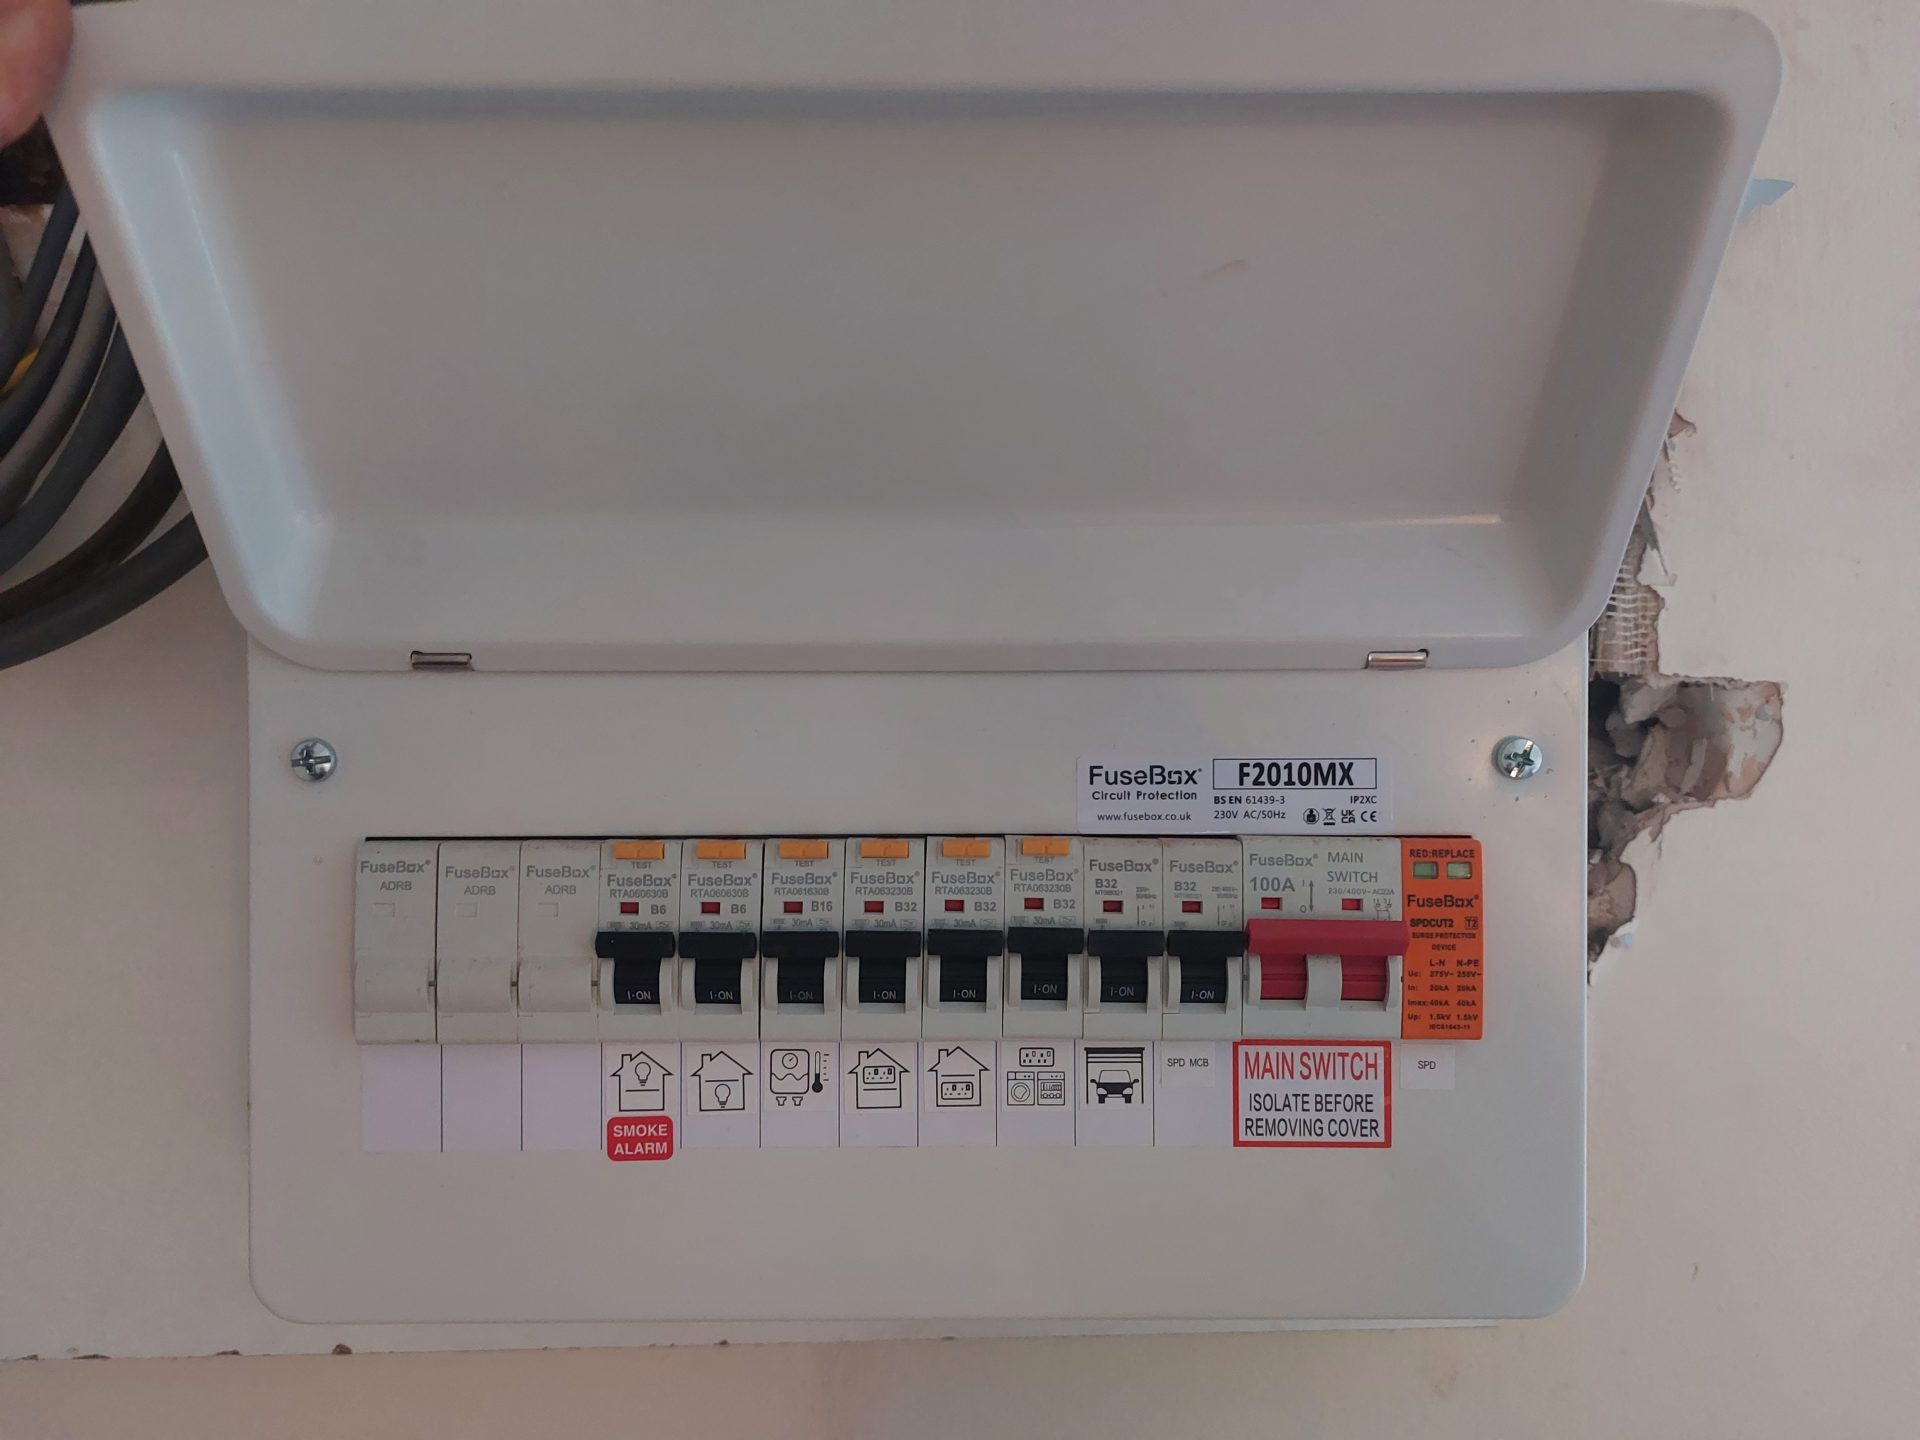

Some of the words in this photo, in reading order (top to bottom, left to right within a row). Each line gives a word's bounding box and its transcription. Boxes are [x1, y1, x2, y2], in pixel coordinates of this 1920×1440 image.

[1089, 764, 1199, 786] FuseBox
[1238, 761, 1354, 787] F2010MX
[1091, 789, 1131, 801] Circuit
[1136, 789, 1197, 801] Protection
[1213, 795, 1226, 805] BS
[1228, 795, 1242, 804] EN
[1245, 795, 1286, 805] 61439-3
[1350, 795, 1377, 805] IP2XC
[1096, 810, 1192, 822] www.fusebox.co.uk
[1213, 810, 1239, 820] 230V
[1243, 810, 1287, 820] AC/50Hz
[876, 858, 897, 867] TEST
[955, 859, 976, 867] TEST
[1034, 856, 1055, 864] TEST
[1249, 853, 1313, 867] FuseBox
[1327, 851, 1364, 864] MAIN
[360, 860, 425, 874] FuseBox
[631, 861, 653, 869] TEST
[712, 860, 733, 869] TEST
[794, 860, 814, 868] TEST
[1089, 859, 1153, 873] FuseBox
[1169, 860, 1234, 874] FuseBox
[445, 866, 509, 880] FuseBox
[526, 865, 590, 879] FuseBox
[1010, 868, 1075, 882] FuseBox
[1327, 871, 1379, 883] SWITCH
[607, 874, 672, 887] FuseBox
[687, 873, 752, 887] FuseBox
[771, 872, 832, 885] FuseBox
[850, 871, 915, 885] FuseBox
[931, 871, 995, 885] FuseBox
[1095, 878, 1119, 889] B32
[380, 880, 412, 892] ADRB
[544, 884, 577, 895] ADRB
[1174, 881, 1197, 892] B32
[1249, 876, 1296, 893] 100A
[464, 886, 496, 896] ADRB
[811, 901, 833, 912] B16
[894, 901, 917, 912] B32
[974, 901, 997, 912] B32
[1053, 899, 1076, 909] B32
[1407, 894, 1475, 908] FuseBox
[650, 904, 667, 915] B6
[730, 903, 747, 914] B6
[629, 921, 653, 930] 30mA
[710, 921, 733, 930] 30mA
[791, 918, 813, 928] 30mA
[874, 919, 897, 928] 30mA
[953, 918, 977, 928] 30mA
[1032, 916, 1056, 925] 30mA
[1409, 918, 1454, 928] SPDCUT2
[1429, 959, 1446, 967] L-N
[1457, 959, 1479, 967] N-PE
[1166, 1057, 1186, 1068] SPD
[1189, 1057, 1209, 1068] MCB
[1243, 1051, 1295, 1081] MAIN
[1299, 1051, 1379, 1081] SWITCH
[1417, 1060, 1437, 1071] SPD
[1249, 1093, 1310, 1113] ISOLATE
[1314, 1093, 1374, 1113] BEFORE
[613, 1123, 668, 1137] SMOKE
[1244, 1118, 1324, 1137] REMOVING
[1327, 1118, 1380, 1138] COVER
[613, 1141, 668, 1156] ALARM
